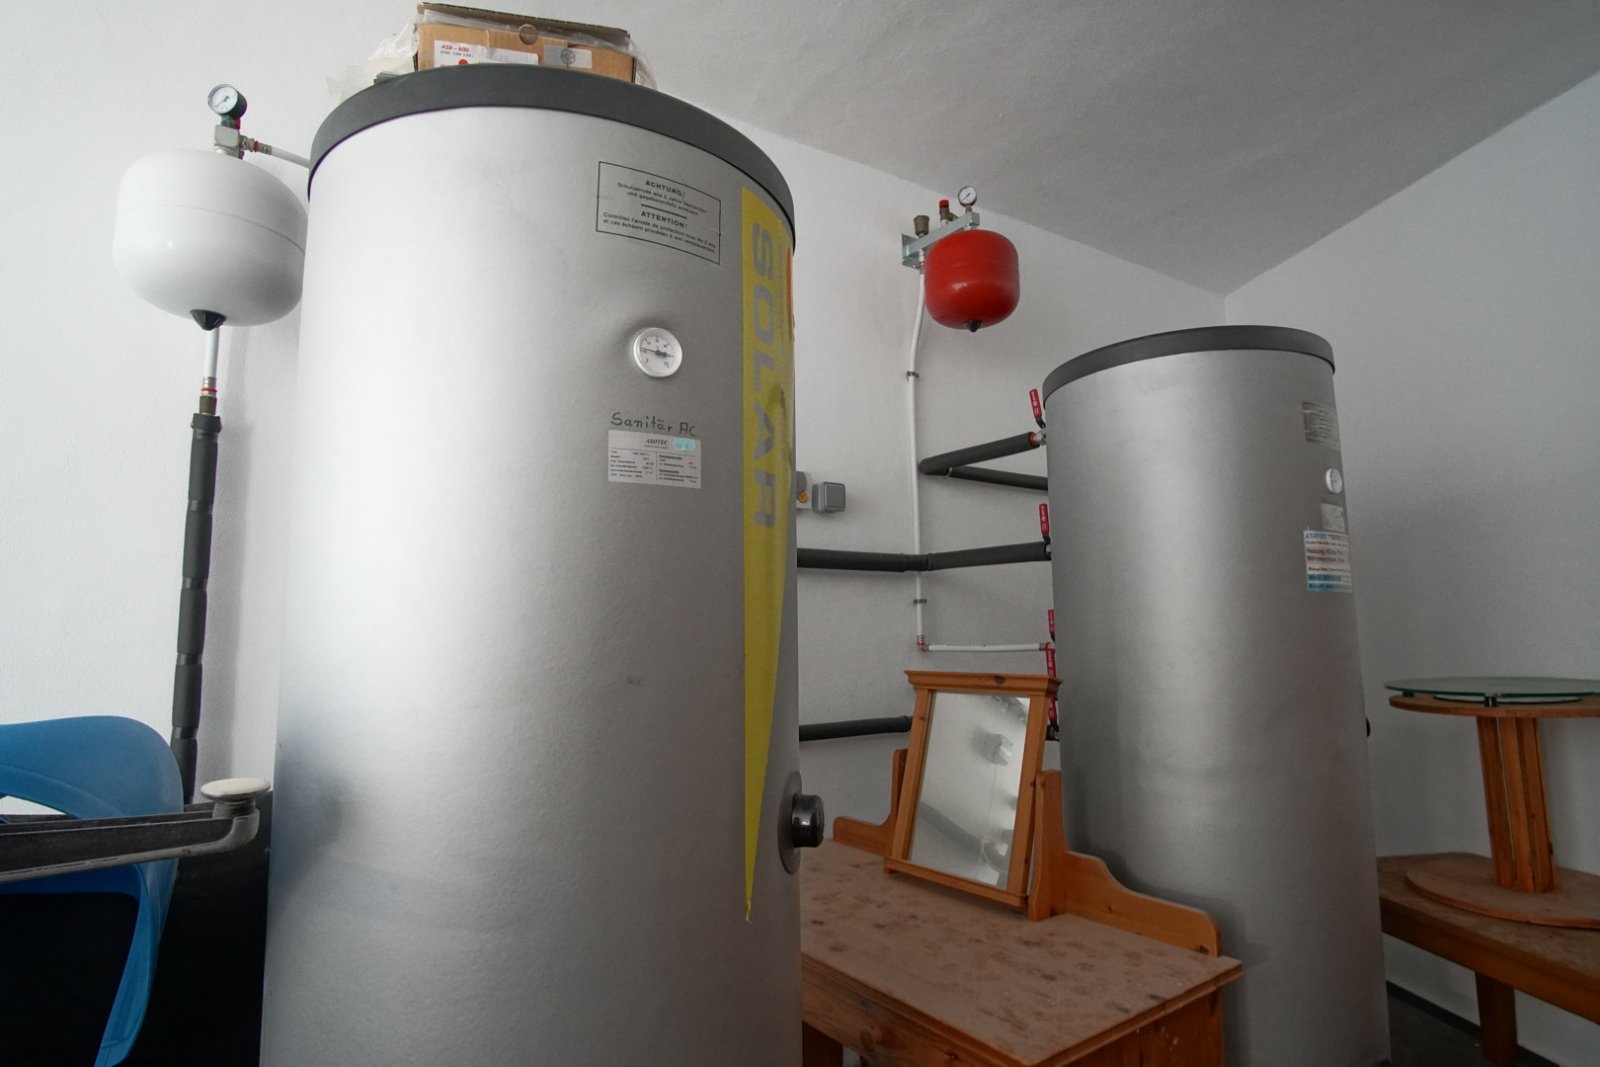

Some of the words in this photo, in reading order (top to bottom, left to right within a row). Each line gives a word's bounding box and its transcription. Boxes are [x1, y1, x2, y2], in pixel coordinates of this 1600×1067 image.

[645, 180, 685, 198] ACHTUNG!
[641, 210, 688, 230] ATTENTION!
[752, 222, 776, 528] SOLAR
[610, 411, 673, 432] Sanitär
